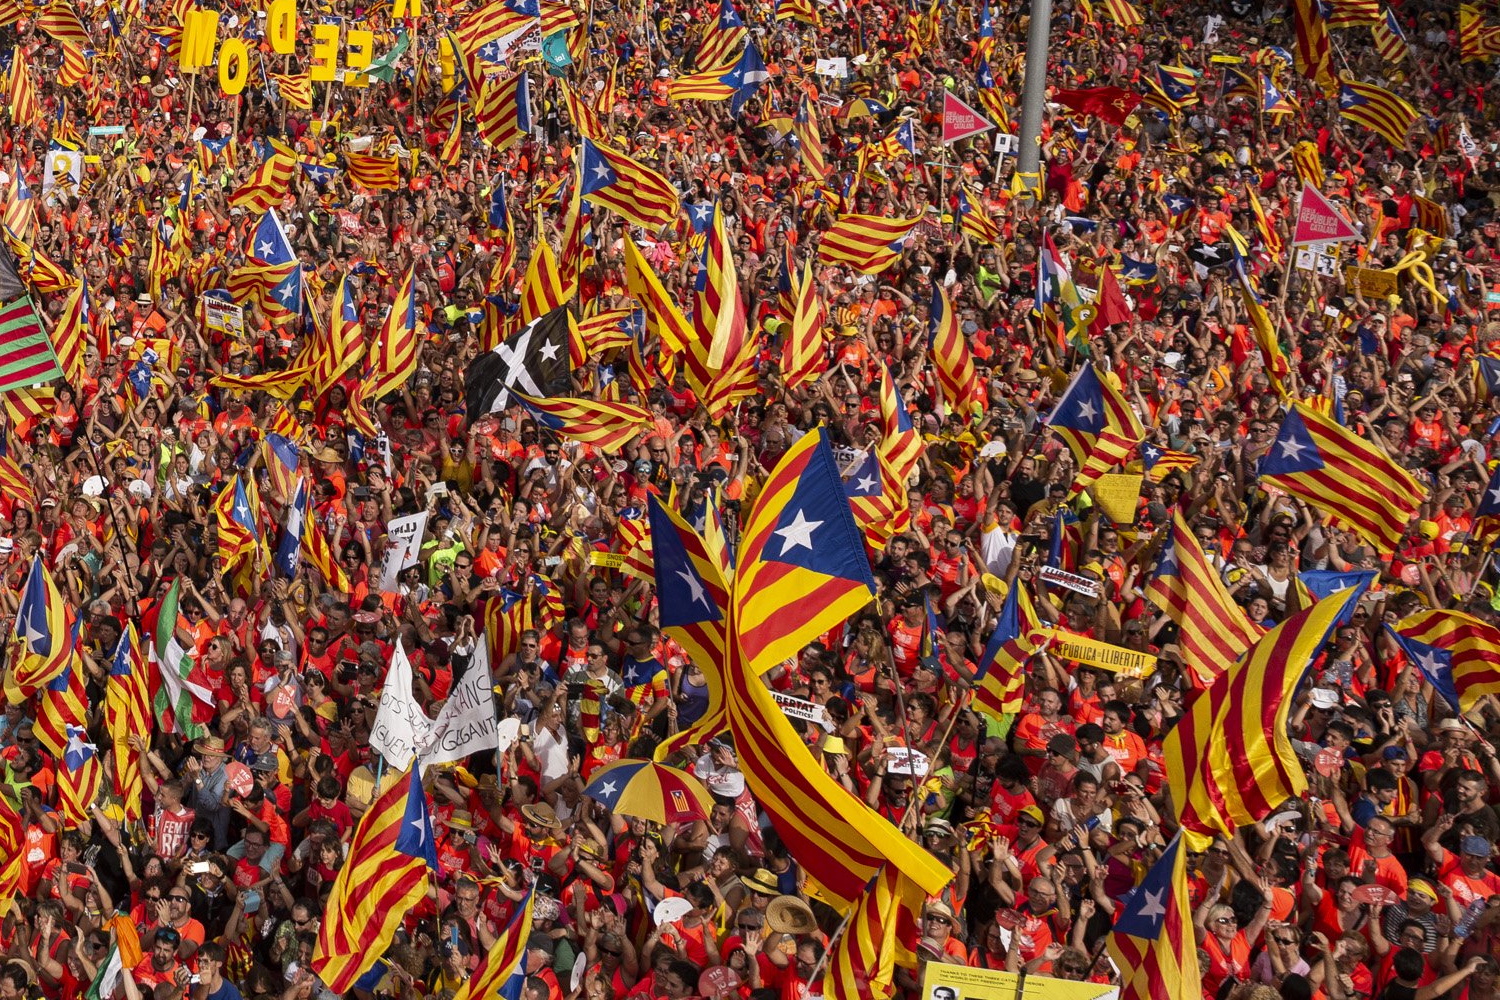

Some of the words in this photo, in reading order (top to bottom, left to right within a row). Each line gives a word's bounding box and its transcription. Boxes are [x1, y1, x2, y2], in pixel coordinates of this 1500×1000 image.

[1300, 212, 1338, 227] REPÚBLICA
[1309, 222, 1338, 235] CATALANA
[1054, 641, 1097, 662] REPÚBLICA
[1100, 650, 1147, 669] LLIBERTAT
[771, 694, 814, 713] IBERTAT
[441, 716, 497, 752] GEGANT
[164, 821, 181, 834] FEM
